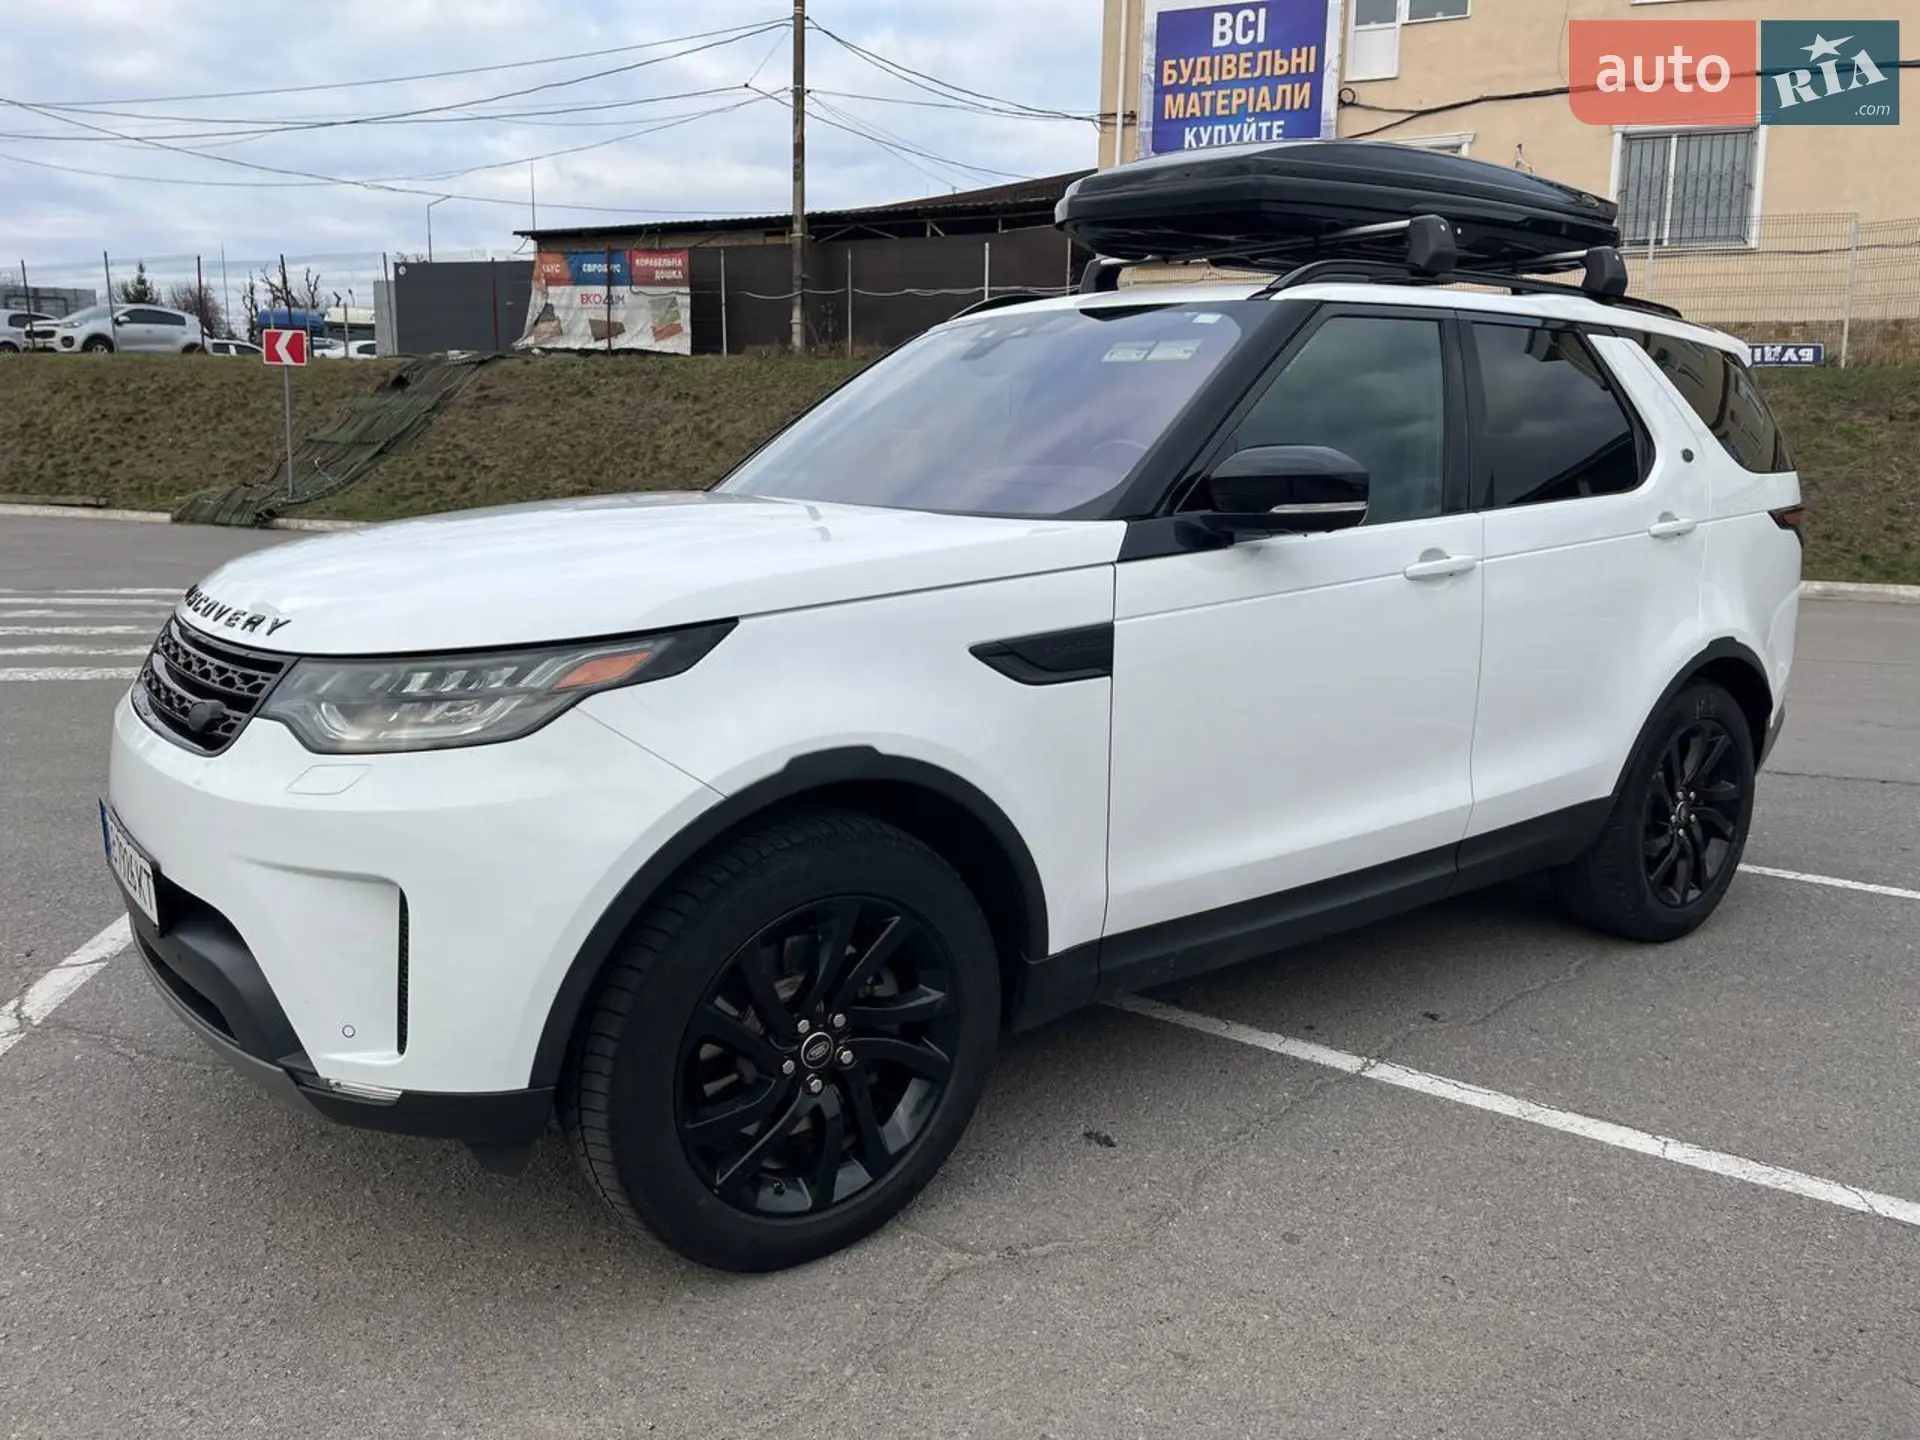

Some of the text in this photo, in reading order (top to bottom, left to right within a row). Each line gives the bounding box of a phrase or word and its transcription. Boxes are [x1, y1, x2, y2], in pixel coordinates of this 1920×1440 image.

[1211, 7, 1267, 48] ВСІ
[1162, 45, 1317, 86] БУДІВЕЛЬНІ
[1163, 82, 1312, 120] МАТЕРІАЛИ
[1184, 117, 1285, 149] КУПУЙТЕ
[581, 263, 621, 273] ЄВРОБУС
[655, 269, 683, 280] ДОШКА
